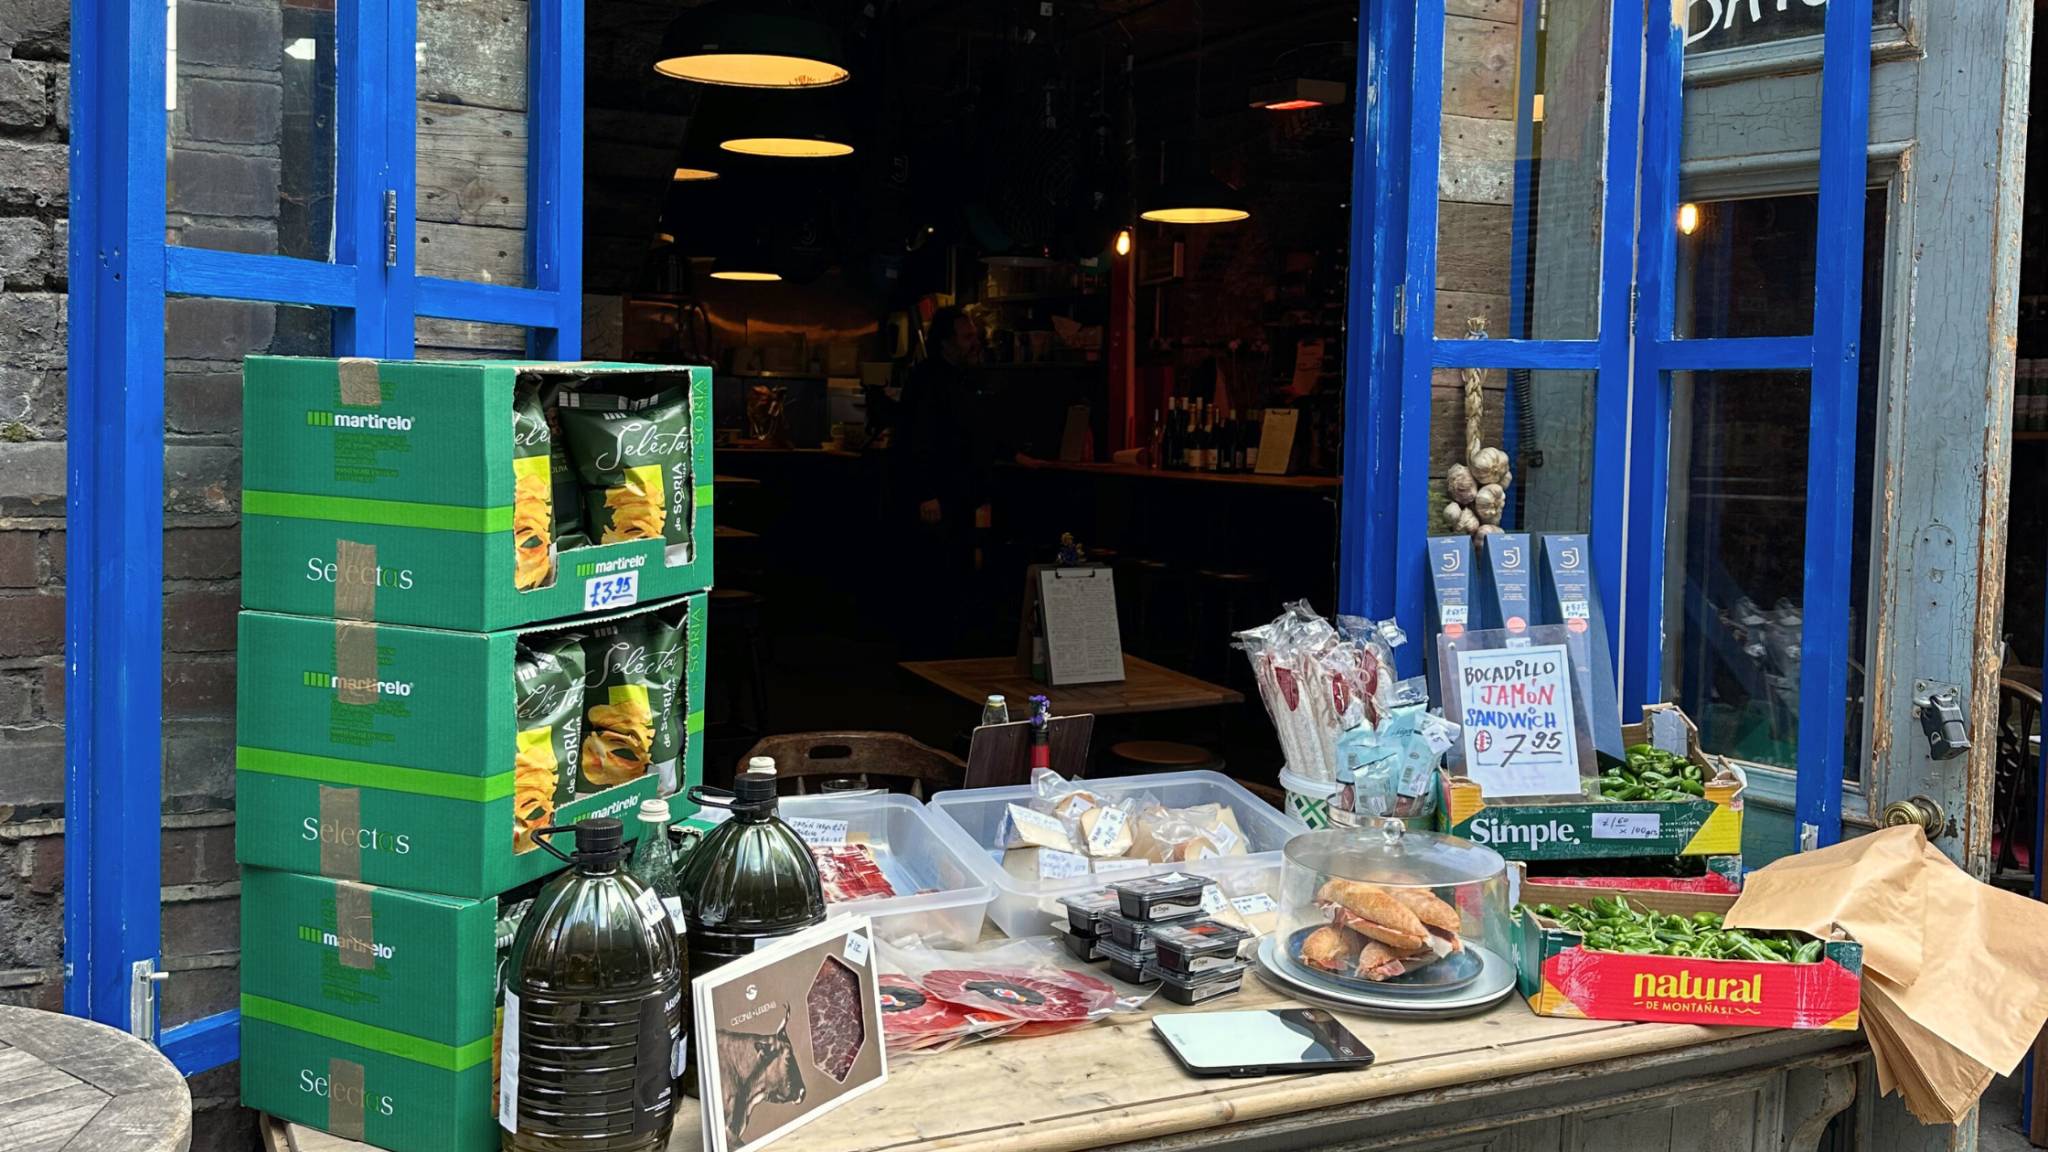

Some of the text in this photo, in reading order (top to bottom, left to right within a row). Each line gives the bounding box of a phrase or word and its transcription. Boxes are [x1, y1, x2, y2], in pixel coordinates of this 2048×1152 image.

[334, 413, 412, 431] martirelo
[692, 380, 706, 446] SORIA
[671, 462, 684, 514] SORIA
[595, 555, 645, 574] martirelo
[689, 607, 702, 673] SORIA
[660, 679, 672, 732] SORIA
[562, 717, 579, 777] SORIA
[302, 816, 410, 855] Selectas
[1469, 817, 1581, 851] Simple.
[1633, 969, 1762, 1004] natural
[1646, 1001, 1660, 1010] DE
[1662, 1002, 1719, 1014] MONTAÑA
